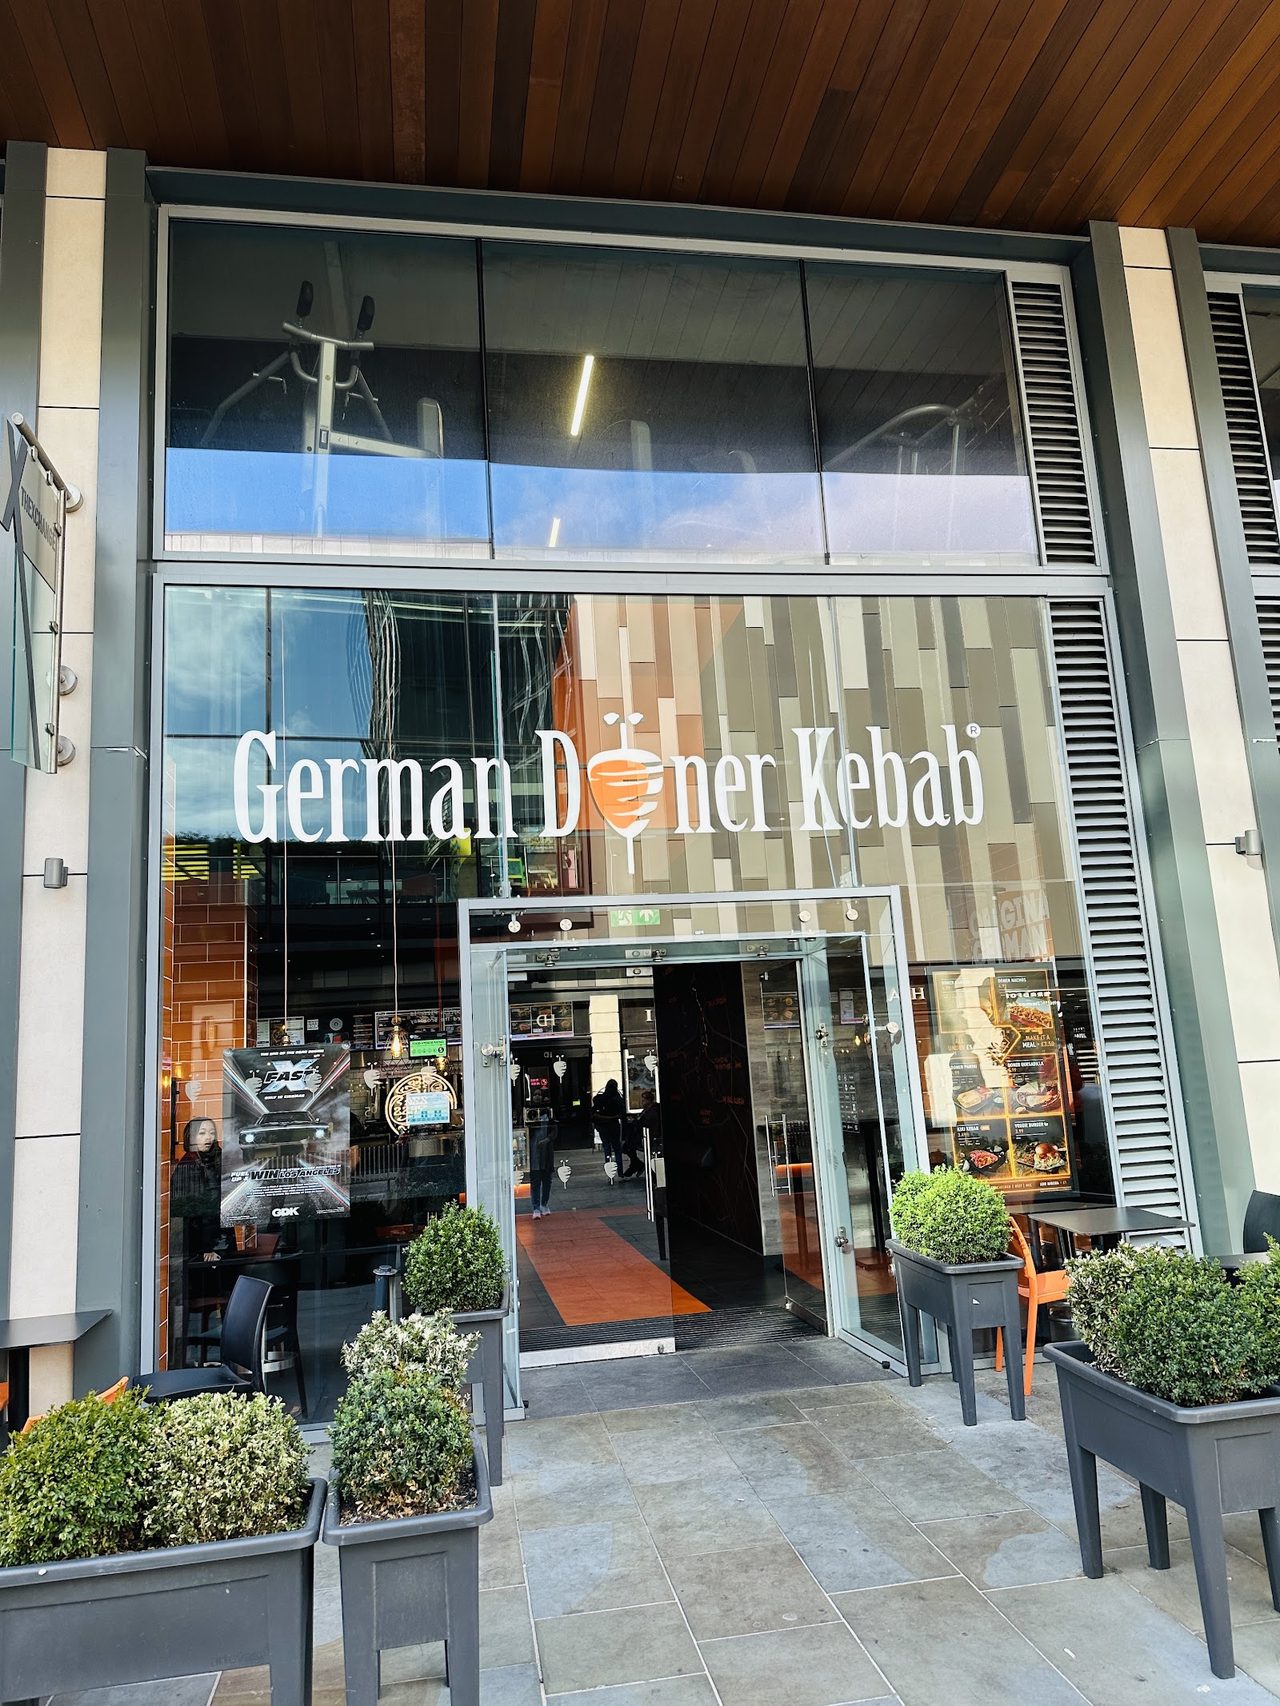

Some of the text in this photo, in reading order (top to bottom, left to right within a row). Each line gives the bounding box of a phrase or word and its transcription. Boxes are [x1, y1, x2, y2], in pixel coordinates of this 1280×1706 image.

[232, 729, 519, 844] German
[250, 1168, 279, 1181] WIN
[279, 1168, 341, 1179] LOS ANGELES
